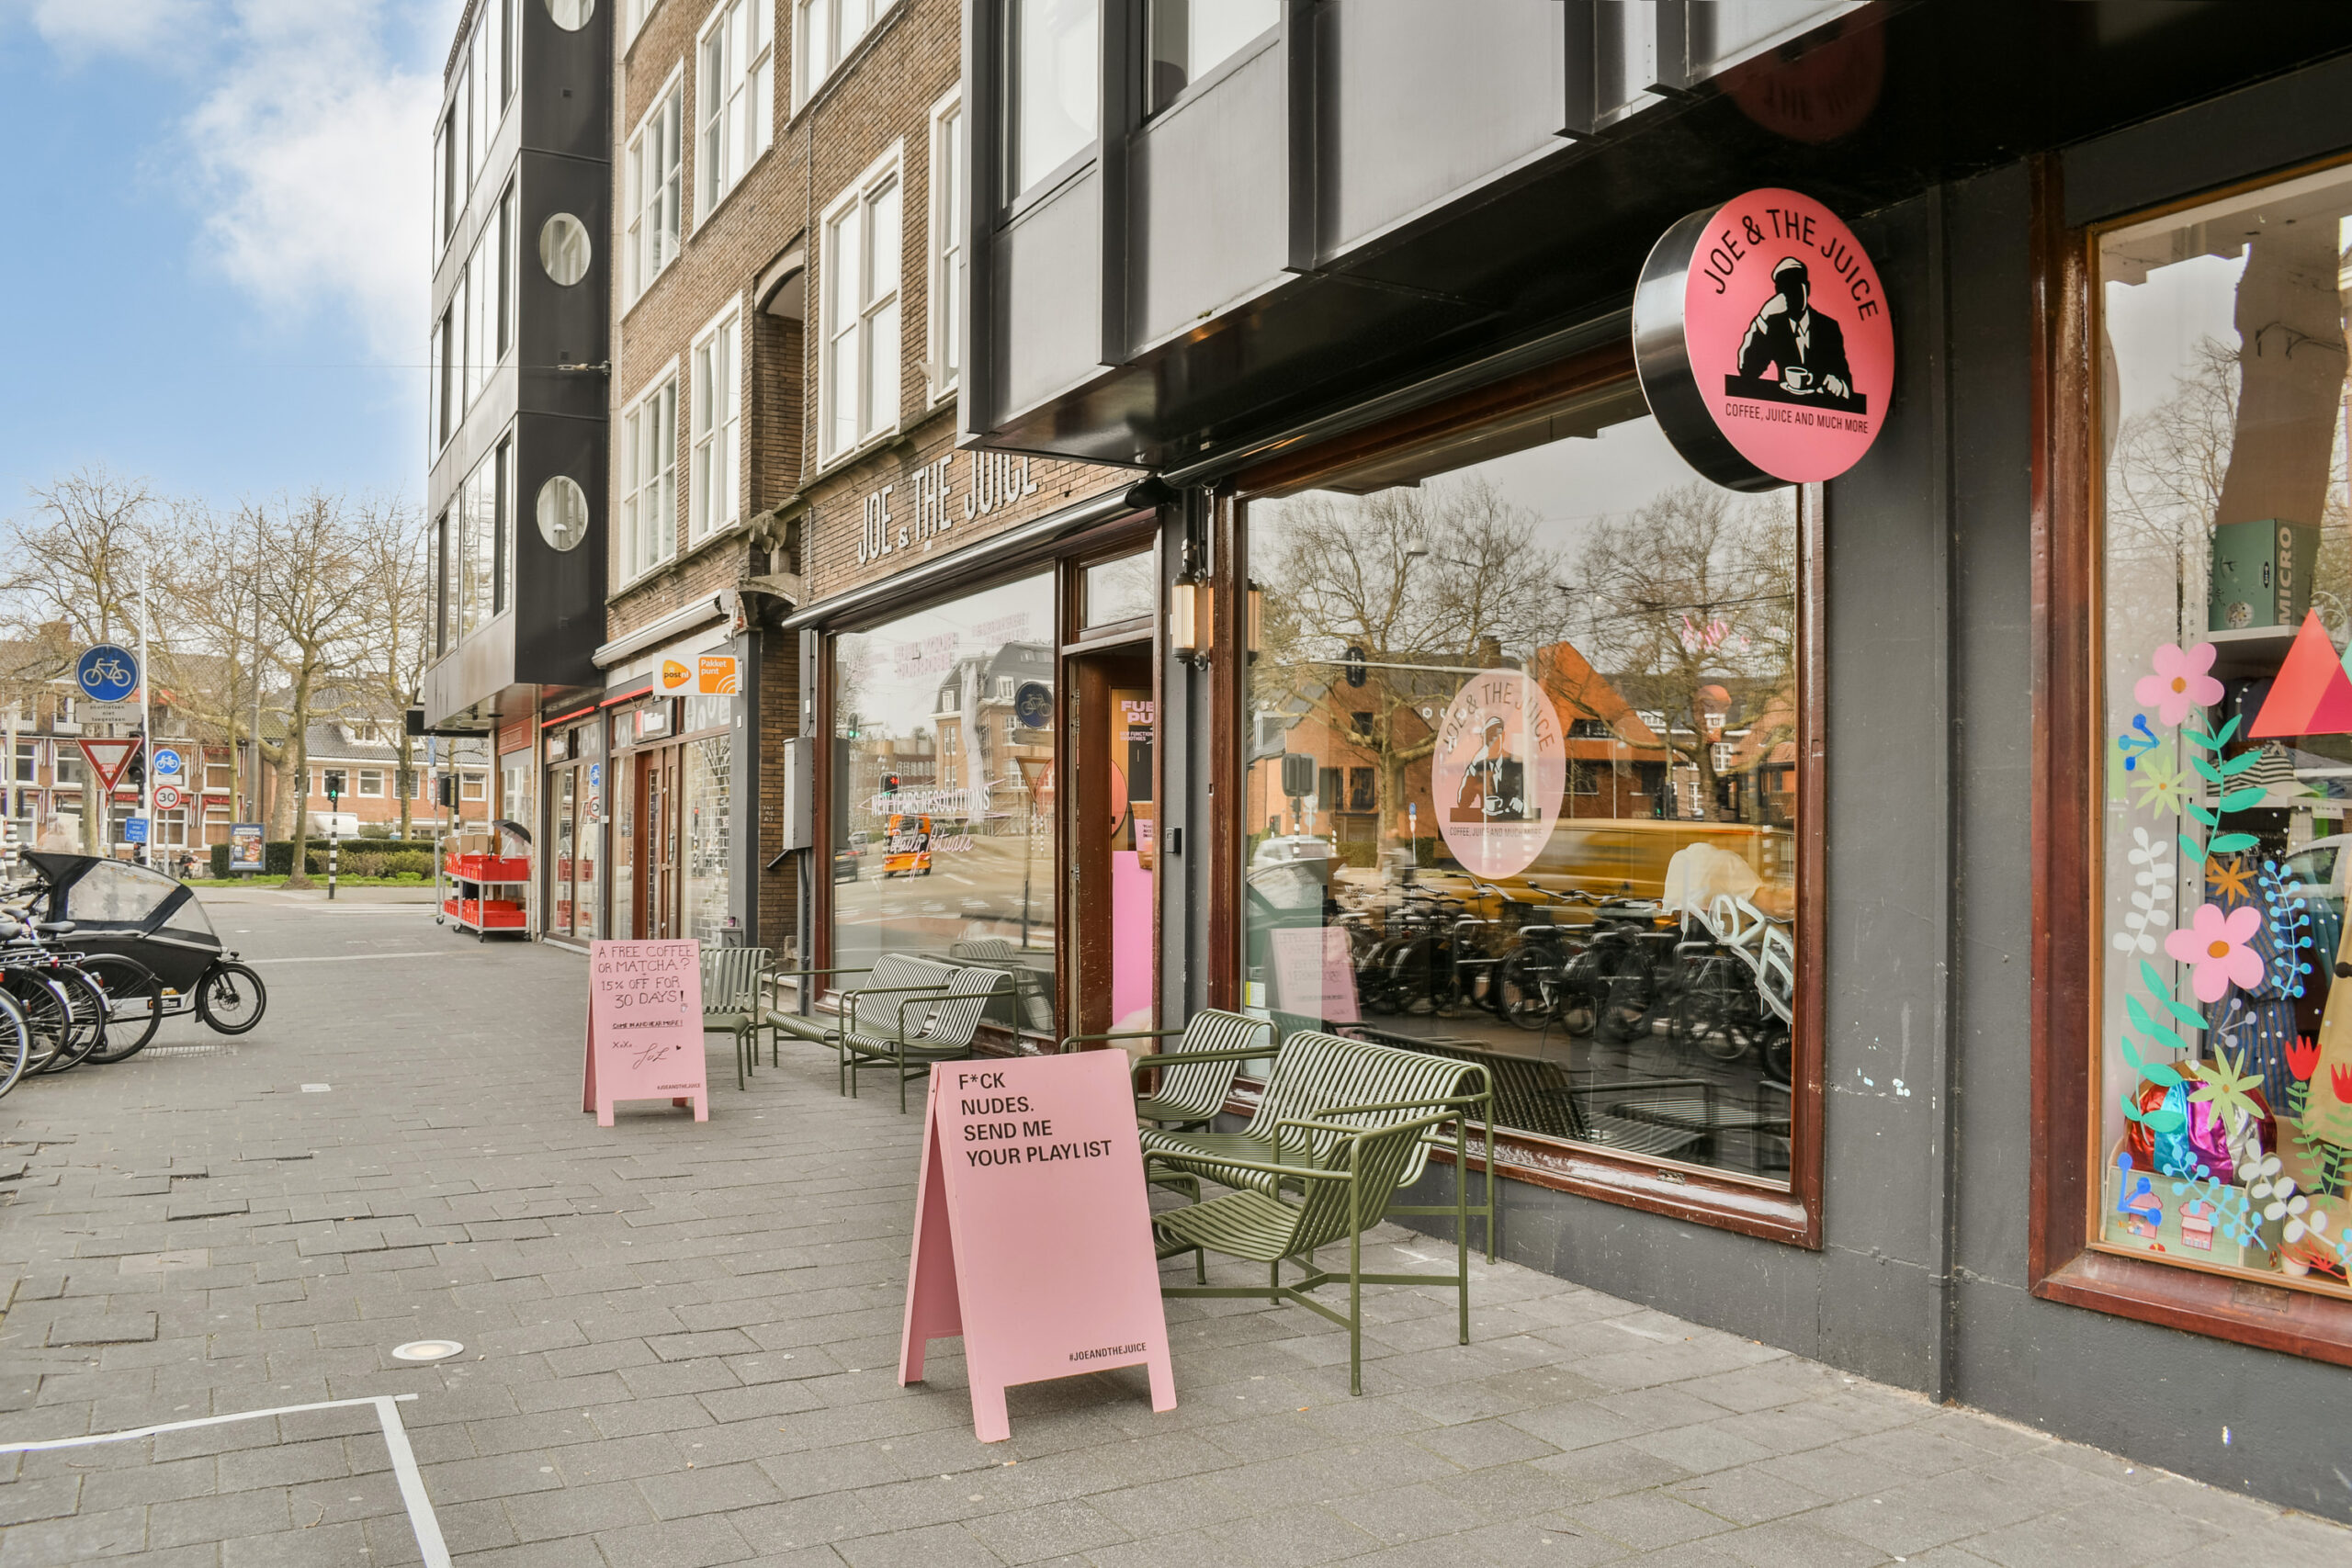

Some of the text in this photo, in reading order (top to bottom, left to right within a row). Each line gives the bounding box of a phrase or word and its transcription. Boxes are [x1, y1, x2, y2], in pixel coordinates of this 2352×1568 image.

[1703, 209, 1879, 321] JOE & THE JUICE
[1765, 408, 1792, 423] JUICE
[1794, 412, 1815, 426] AND
[1816, 414, 1842, 430] MUCH
[1844, 419, 1869, 434] MORE
[858, 484, 894, 564] JOE
[898, 526, 910, 548] &
[912, 454, 953, 541] THE
[2278, 526, 2292, 626] MICRO
[701, 660, 727, 668] Pakket
[701, 668, 719, 676] punt
[1481, 682, 1513, 705] THE
[159, 793, 175, 802] 30
[925, 819, 974, 852] Rituals
[598, 944, 695, 958] A FREE COFFEE
[597, 957, 690, 973] OR MATCHA?
[602, 976, 680, 991] 15% OFF FOR
[615, 993, 633, 1009] 30
[961, 1096, 1035, 1115] NUDES.
[964, 1120, 1053, 1141] SEND ME
[966, 1148, 1021, 1167] YOUR
[1069, 1342, 1147, 1360] #JOEANDTHEJUICE
